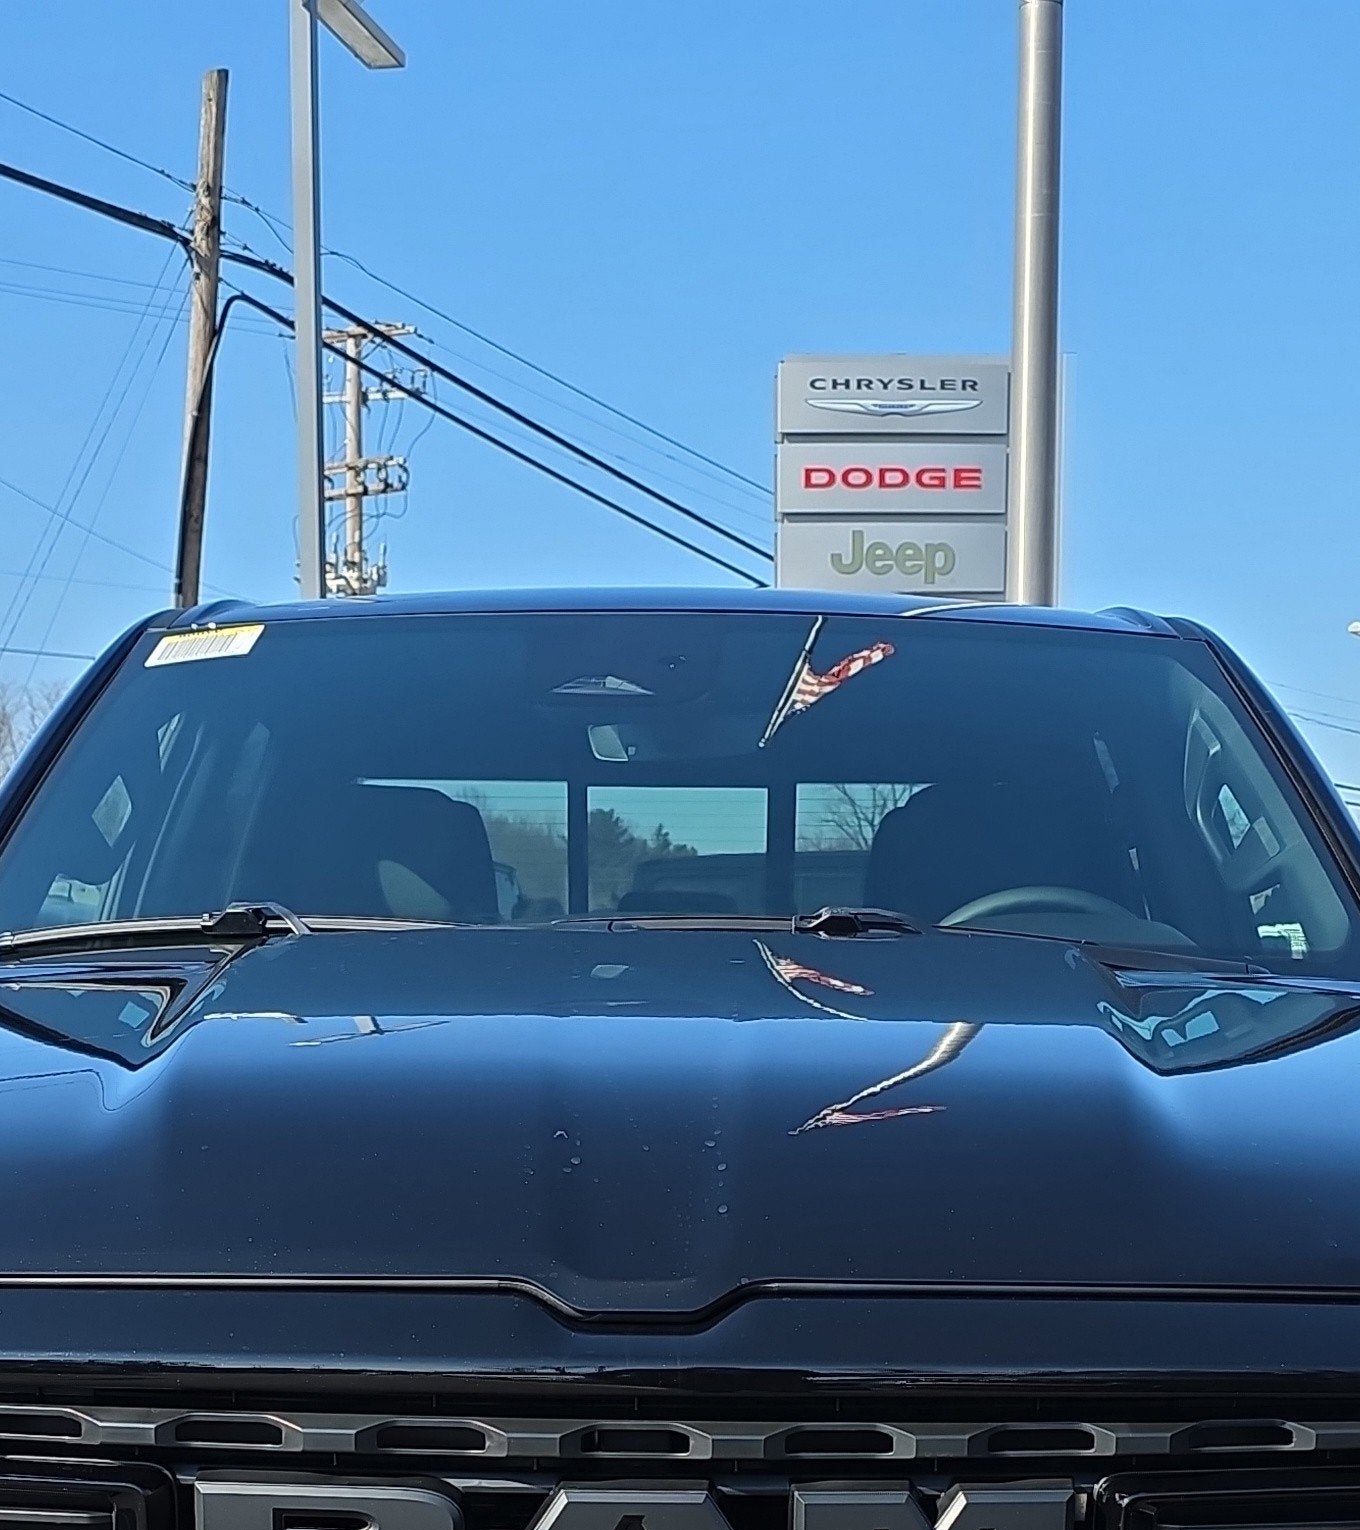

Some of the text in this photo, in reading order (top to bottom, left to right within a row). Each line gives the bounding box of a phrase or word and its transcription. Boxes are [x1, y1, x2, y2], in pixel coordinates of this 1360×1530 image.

[808, 377, 979, 392] CHRYSLER
[803, 467, 983, 490] DODGE
[830, 530, 956, 584] Jeep
